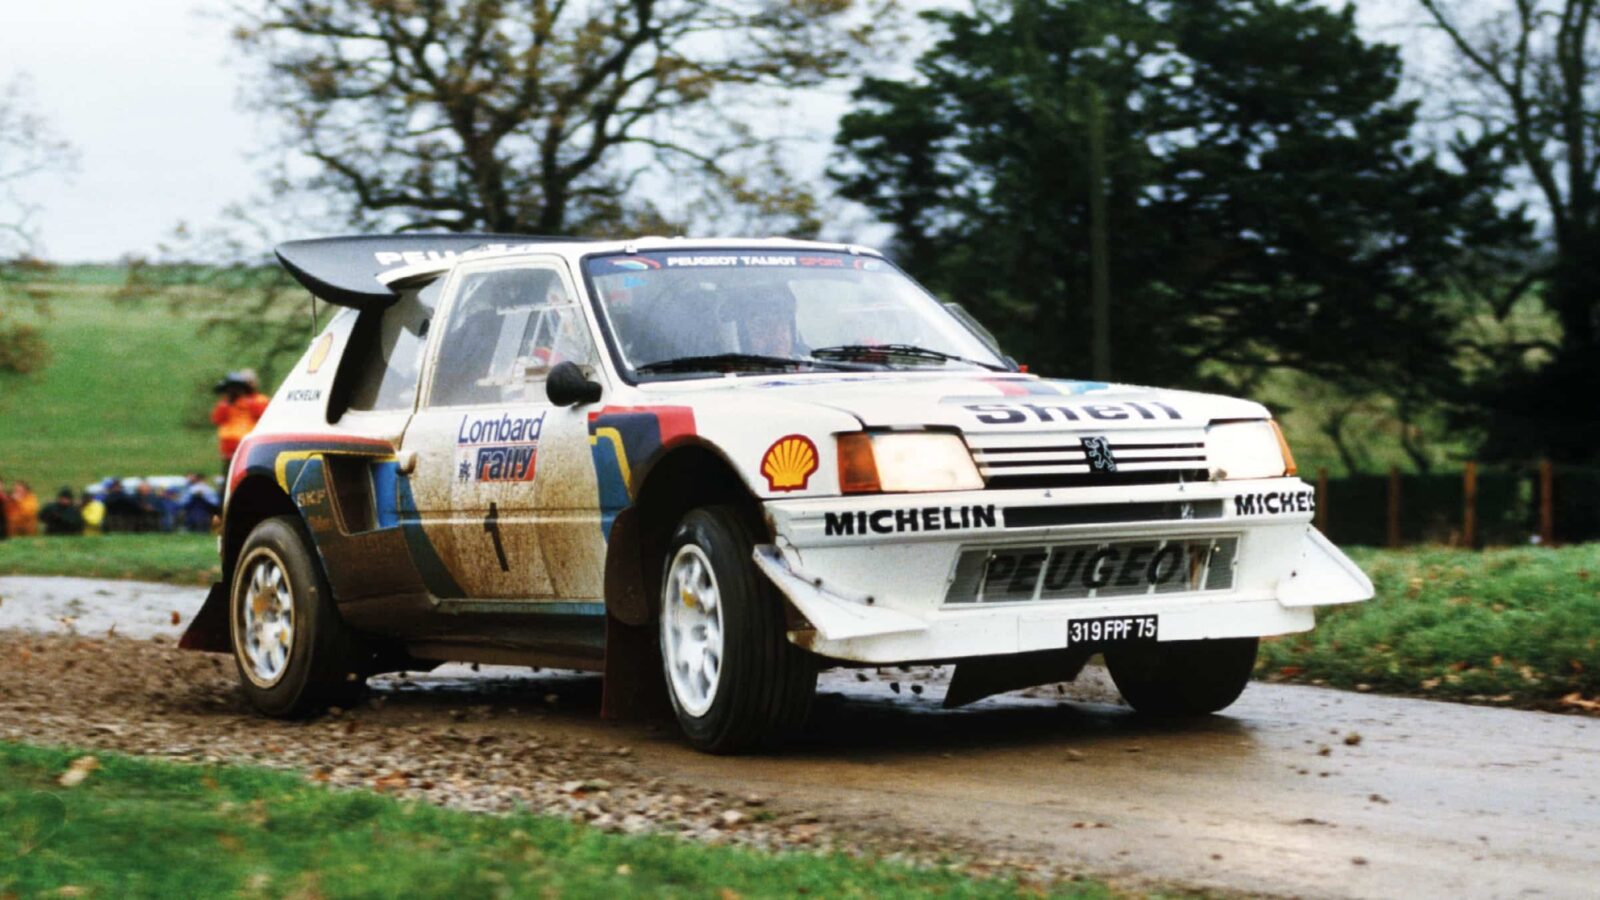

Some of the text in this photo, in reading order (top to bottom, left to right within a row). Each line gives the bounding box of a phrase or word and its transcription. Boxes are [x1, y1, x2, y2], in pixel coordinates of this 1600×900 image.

[666, 255, 738, 267] PEUGEOT
[740, 256, 796, 266] TALBOT
[963, 401, 1183, 424] Shell
[457, 410, 547, 444] Lombard
[477, 446, 537, 481] rally
[824, 504, 996, 536] MICHELIN
[1071, 617, 1157, 642] 319 FPF 75
